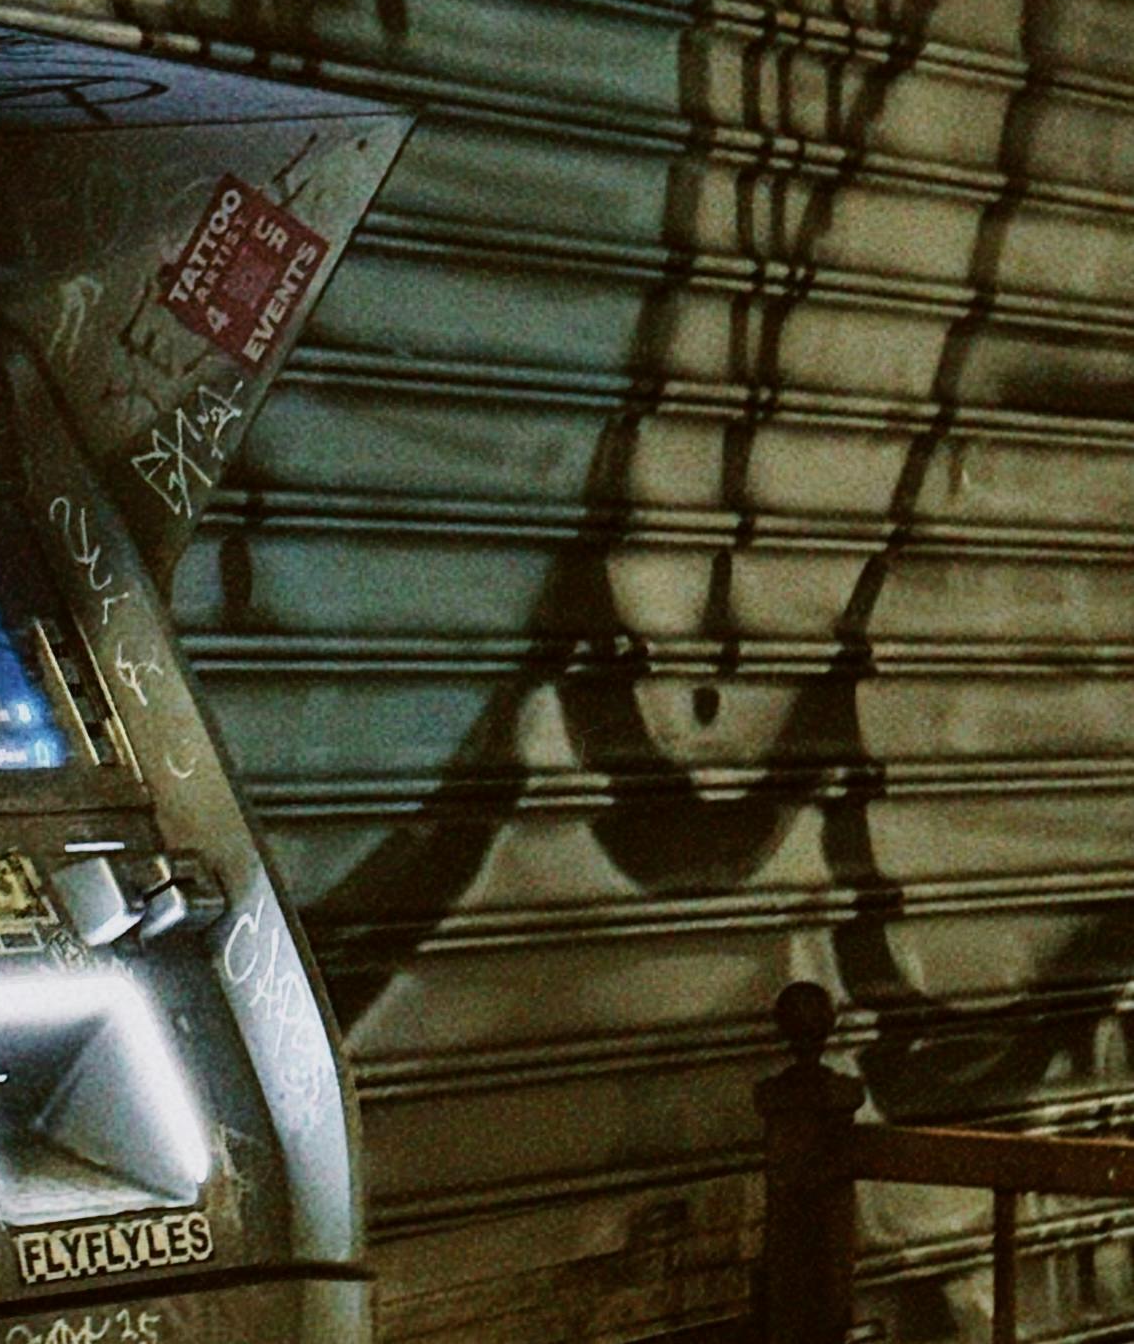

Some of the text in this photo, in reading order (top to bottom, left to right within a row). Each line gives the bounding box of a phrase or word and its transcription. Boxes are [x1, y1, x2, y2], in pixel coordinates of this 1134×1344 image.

[168, 189, 243, 302] TATTOO
[254, 215, 290, 254] UR
[206, 305, 231, 334] 4
[241, 240, 317, 362] EVENTS
[18, 1213, 212, 1281] FLYFLYLES
